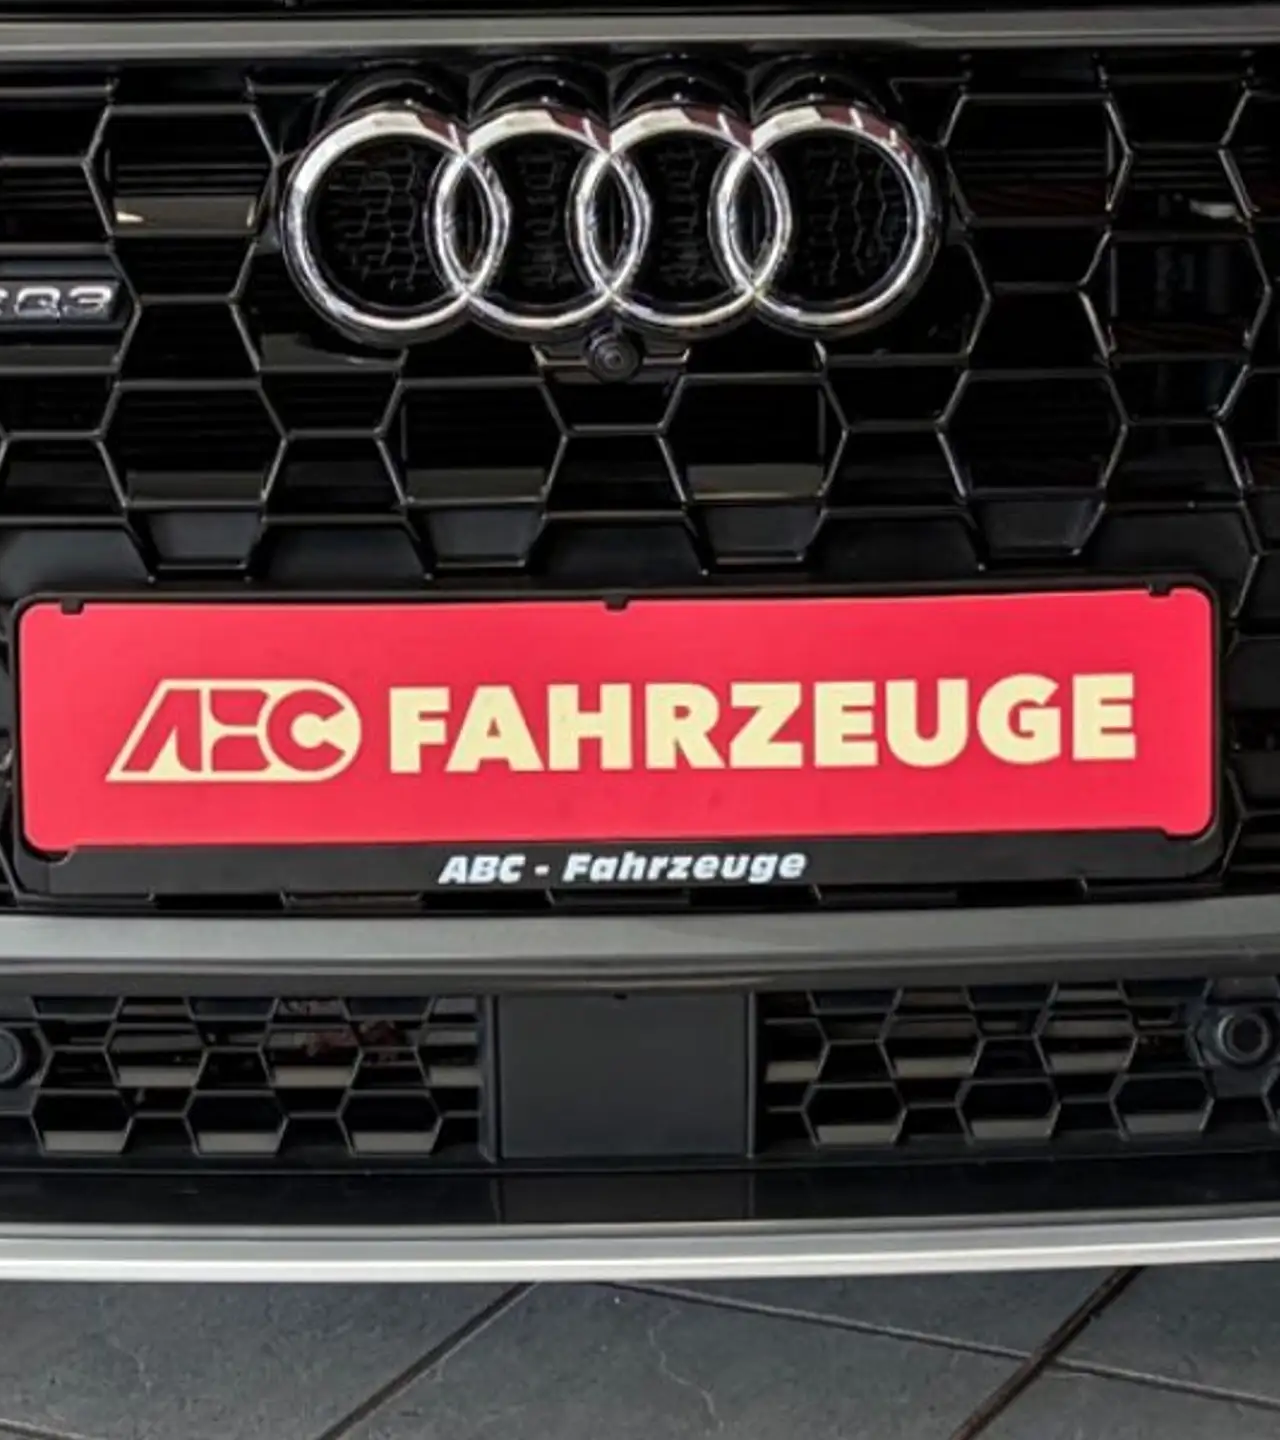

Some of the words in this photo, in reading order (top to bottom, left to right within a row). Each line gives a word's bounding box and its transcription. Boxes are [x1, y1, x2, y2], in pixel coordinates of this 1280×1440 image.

[388, 672, 1137, 775] FAHRZEUGE
[437, 854, 525, 885] ABC
[562, 851, 808, 885] Fahrzeuge
